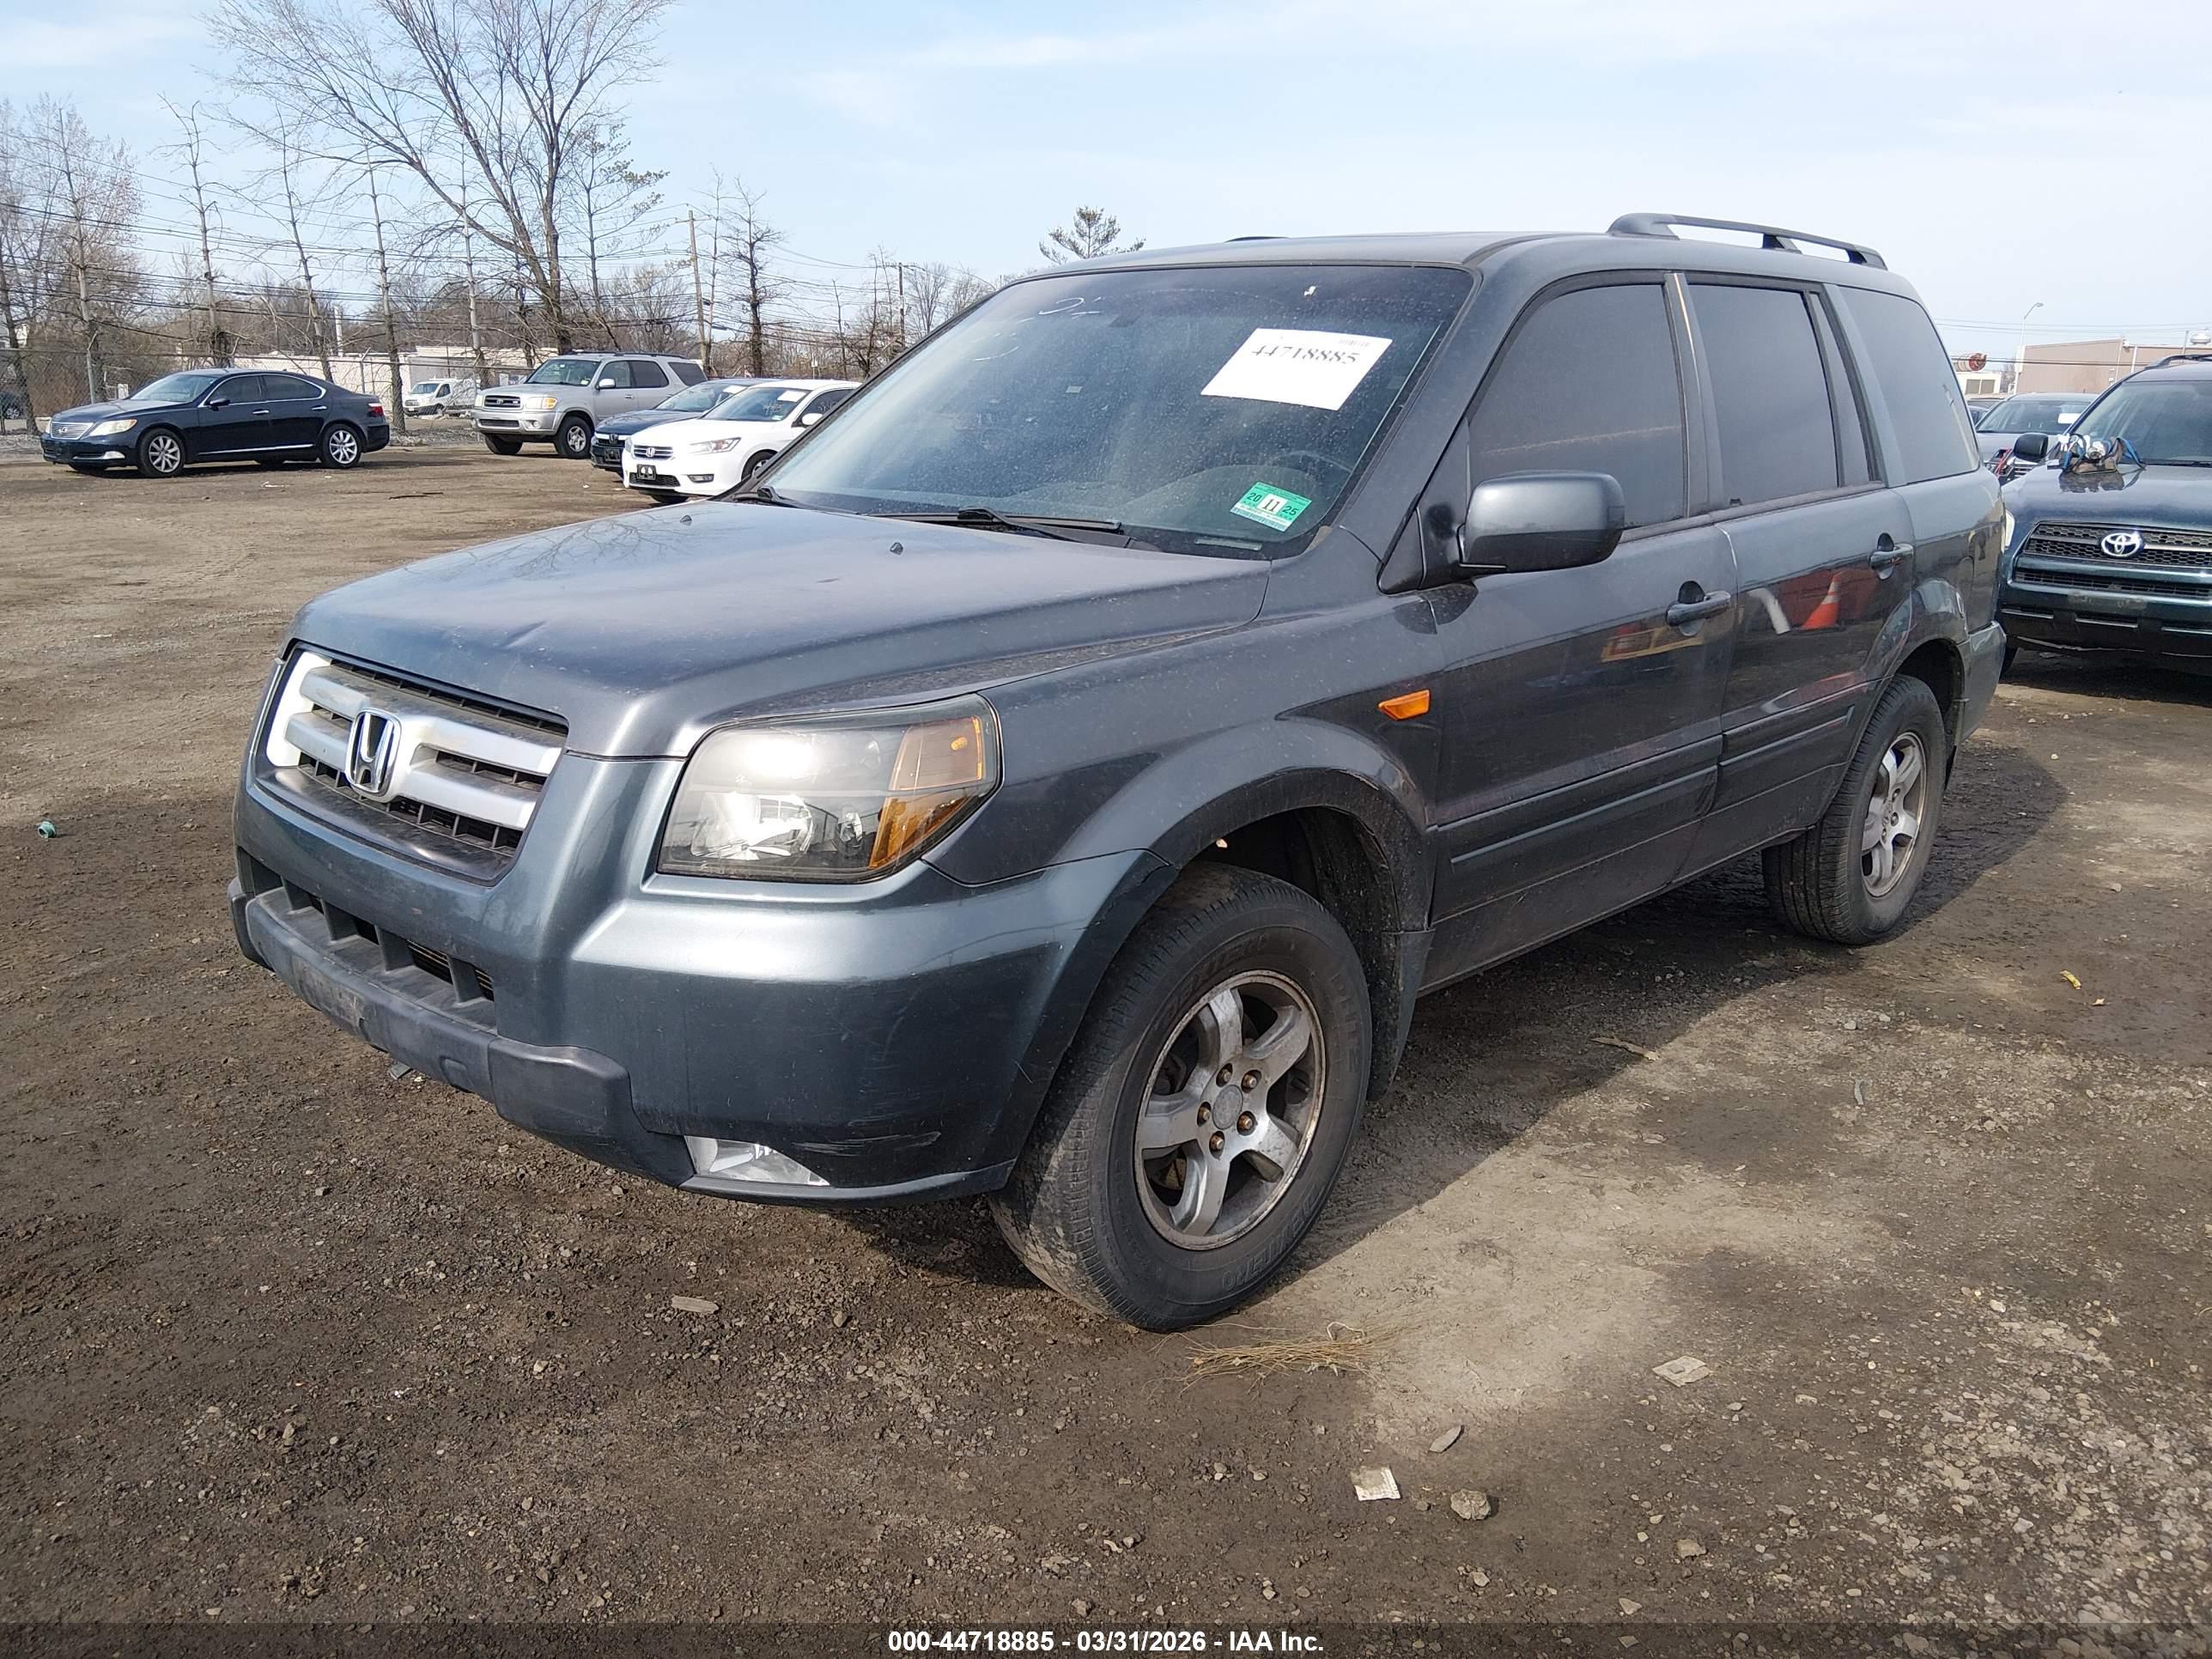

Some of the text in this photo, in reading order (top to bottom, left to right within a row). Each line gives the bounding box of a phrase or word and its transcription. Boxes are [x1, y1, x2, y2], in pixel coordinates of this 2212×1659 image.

[1251, 345, 1361, 365] 44718885
[1246, 492, 1262, 503] 20
[1261, 498, 1280, 513] 11
[1282, 505, 1300, 517] 25
